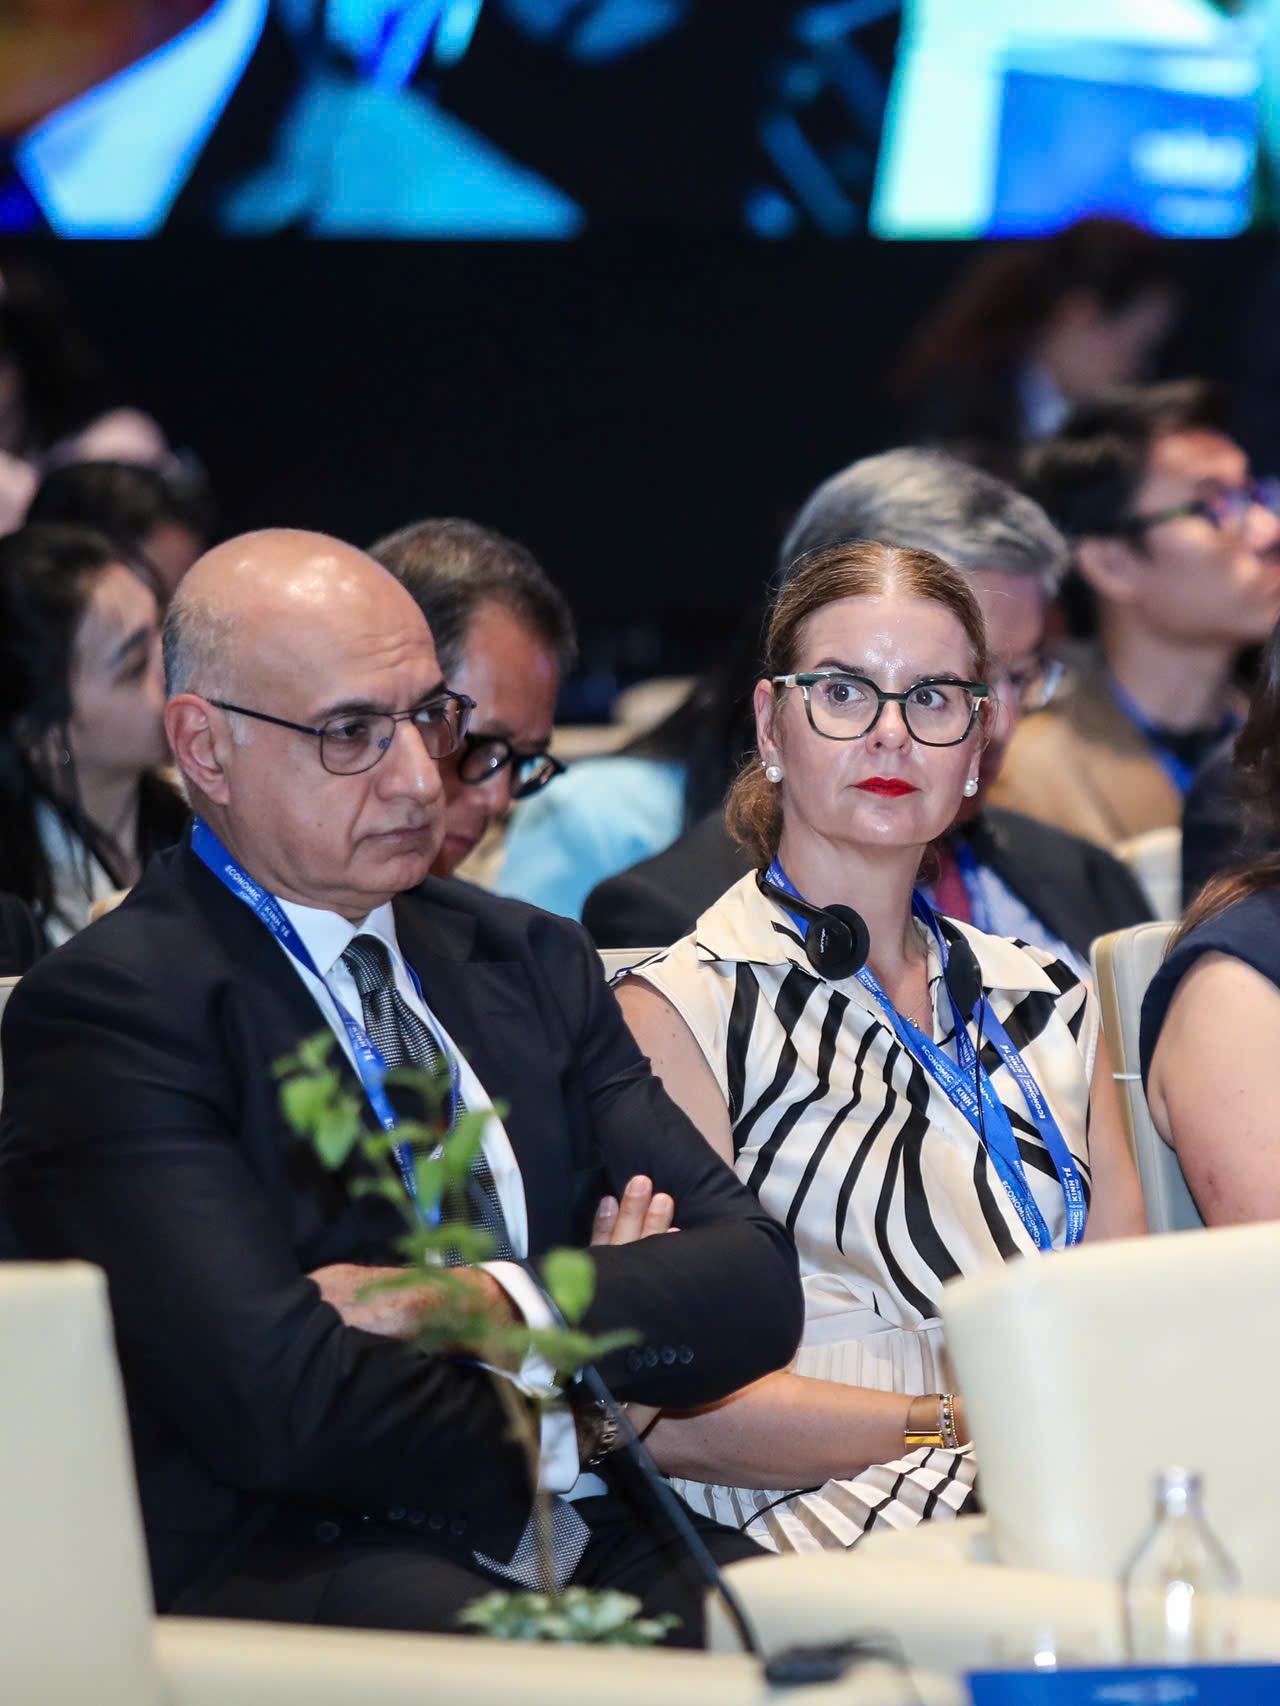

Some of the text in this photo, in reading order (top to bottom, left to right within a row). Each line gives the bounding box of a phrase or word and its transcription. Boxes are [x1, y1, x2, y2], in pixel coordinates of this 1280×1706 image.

[224, 864, 262, 901] ECONOMIC
[921, 1044, 955, 1083] ECONOMIC
[1009, 1055, 1023, 1073] KINH
[955, 1086, 971, 1107] KINH
[1024, 1079, 1046, 1119] ECONOMIC
[1061, 1166, 1078, 1202] KINH TẾ
